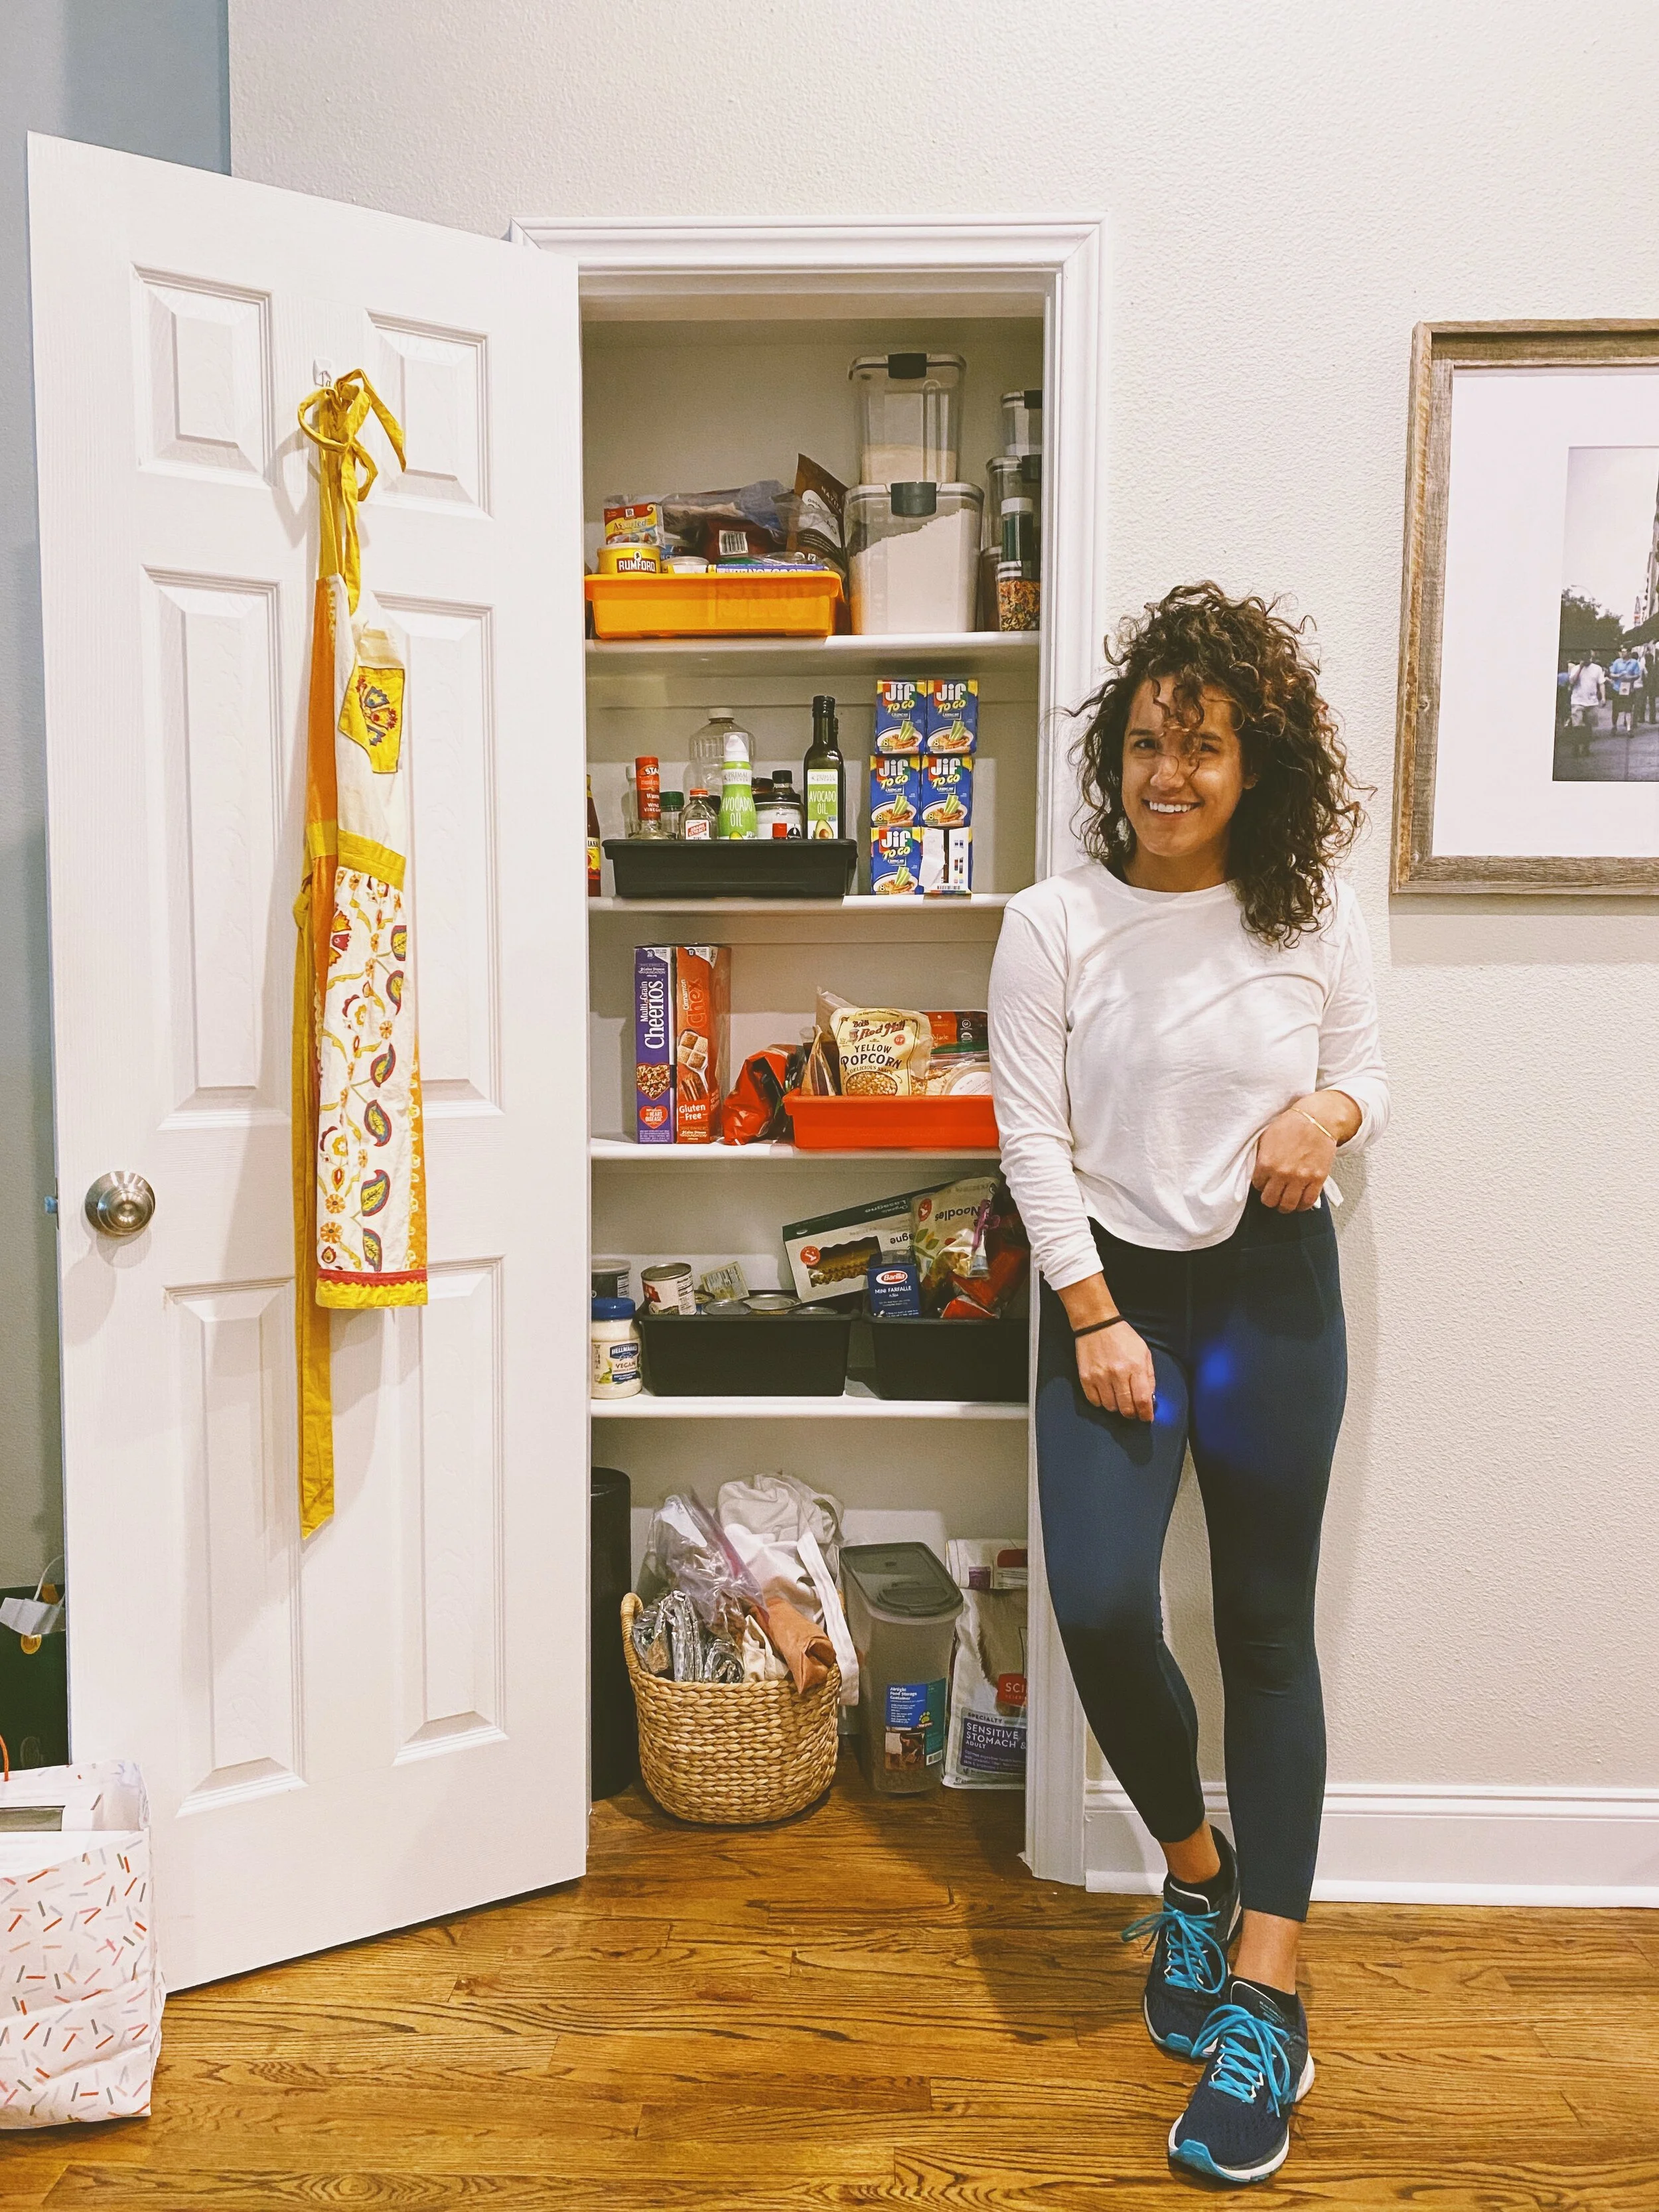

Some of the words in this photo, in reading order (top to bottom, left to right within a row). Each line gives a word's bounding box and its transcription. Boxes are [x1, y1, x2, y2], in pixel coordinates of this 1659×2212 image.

[618, 559, 656, 571] RUMFORD
[885, 684, 916, 701] Jif
[936, 684, 967, 701] Jif
[887, 703, 901, 713] TO
[901, 700, 915, 709] GO
[938, 703, 952, 713] TO
[952, 700, 966, 709] GO
[879, 759, 908, 776] Jif
[930, 758, 961, 776] Jif
[881, 778, 894, 789] TO
[895, 774, 908, 784] GO
[932, 777, 946, 788] TO
[946, 774, 960, 784] GO
[809, 790, 836, 802] AVOCADO
[721, 797, 753, 812] AVOCADO
[817, 802, 828, 814] OIL
[730, 812, 743, 827] OIL
[881, 830, 911, 848] Jif
[883, 849, 896, 861] TO
[897, 846, 910, 855] GO
[640, 981, 648, 1000] Grain
[687, 978, 708, 1028] Chex
[640, 1003, 648, 1022] Multi
[644, 980, 665, 1049] Cheerios
[858, 1024, 883, 1042] Red
[881, 1020, 906, 1037] Mill
[854, 1044, 893, 1053] YELLOW
[840, 1053, 902, 1072] POPCORN
[679, 1104, 706, 1114] Gluten
[934, 1206, 981, 1221] Noodles
[890, 1232, 913, 1244] agne
[968, 1712, 1003, 1724] SPECIALTY
[966, 1722, 1019, 1739] SENSITIVE
[966, 1732, 1016, 1748] STOMACH
[966, 1740, 986, 1749] ADULT
